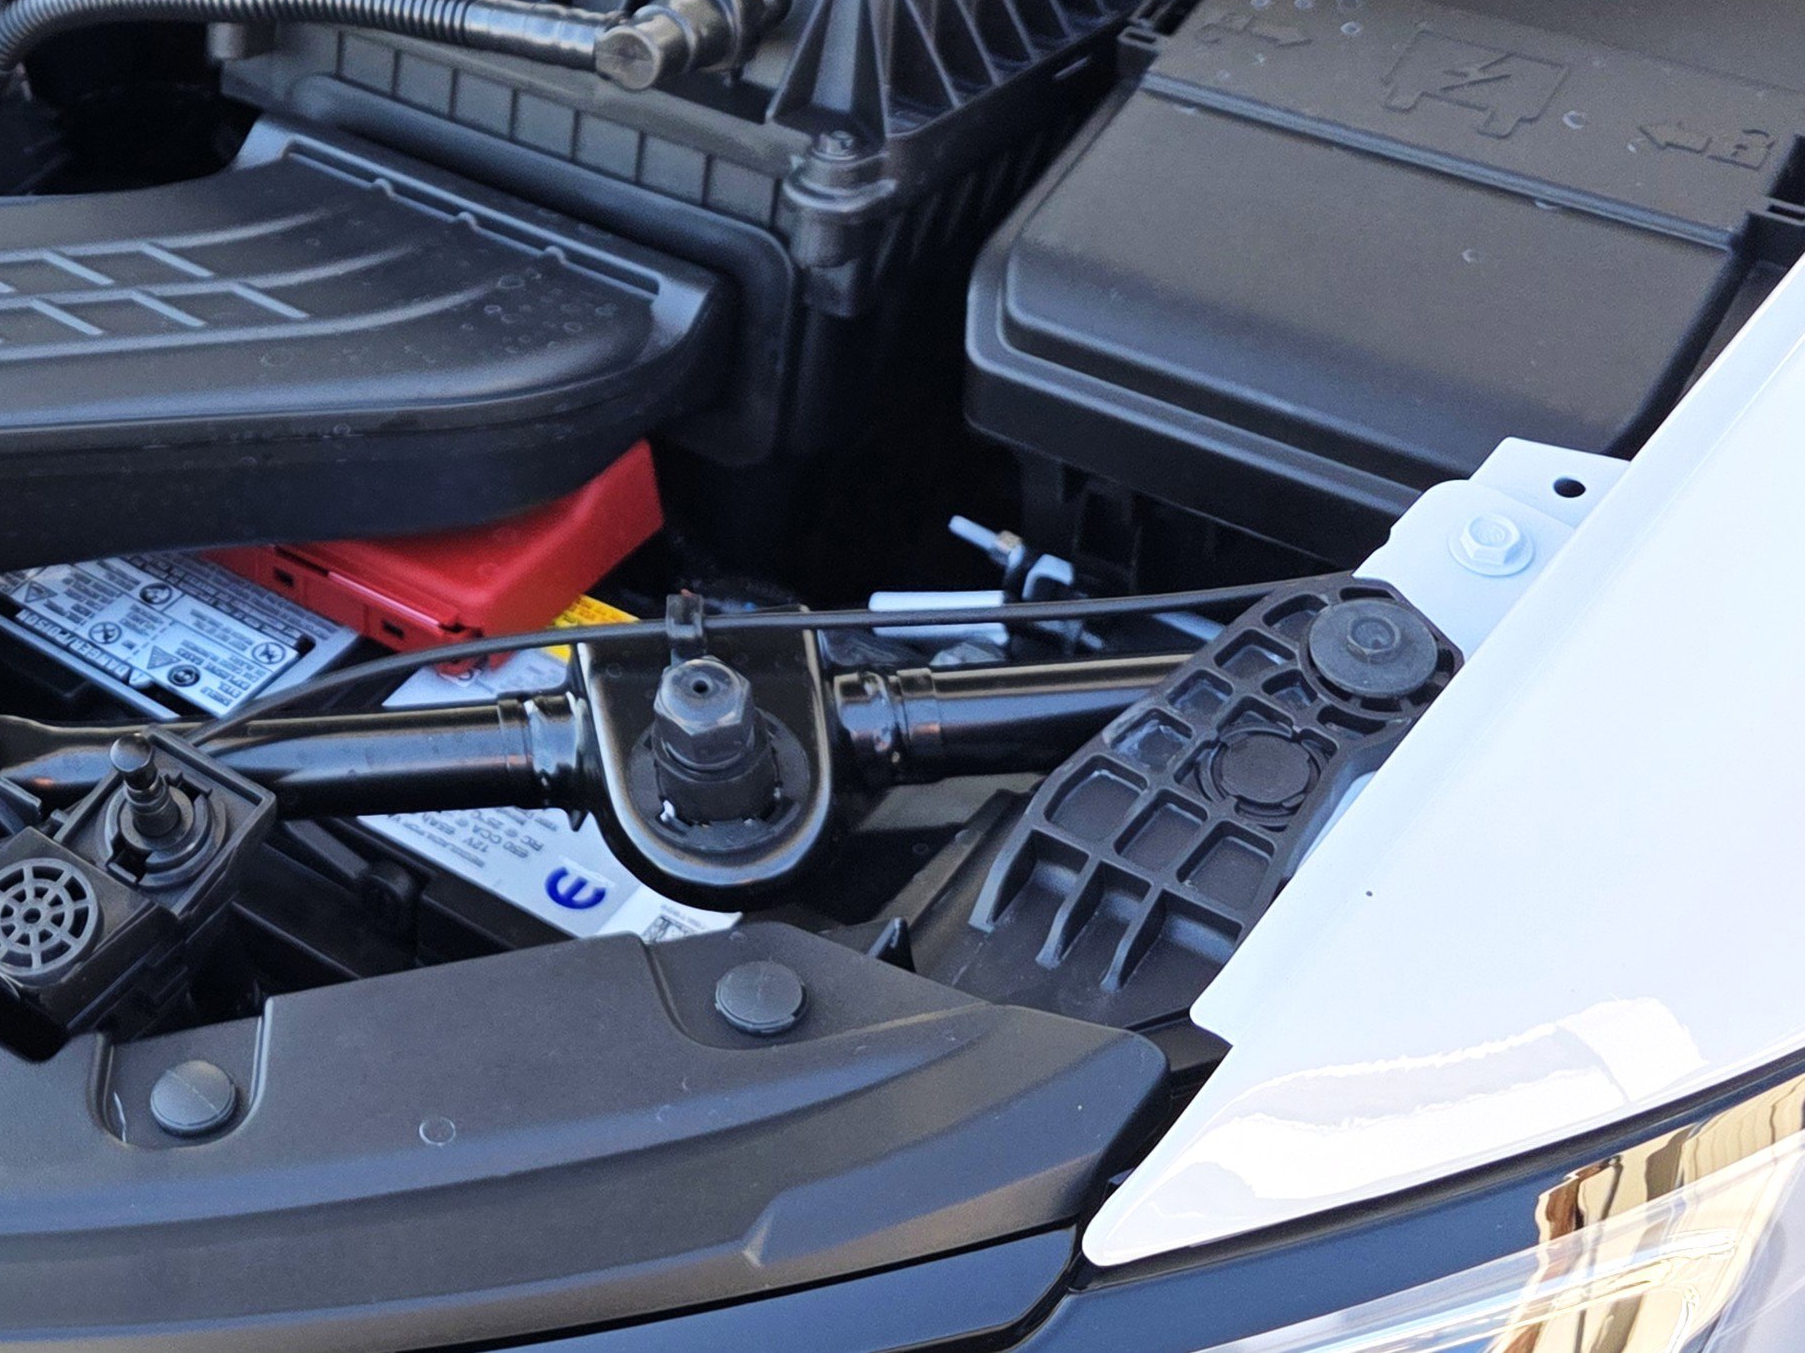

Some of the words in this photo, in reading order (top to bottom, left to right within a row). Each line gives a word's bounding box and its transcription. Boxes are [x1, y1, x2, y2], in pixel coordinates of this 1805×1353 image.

[15, 610, 129, 677] DANGER/POISON
[461, 834, 491, 854] 12V
[468, 823, 504, 845] CCA
